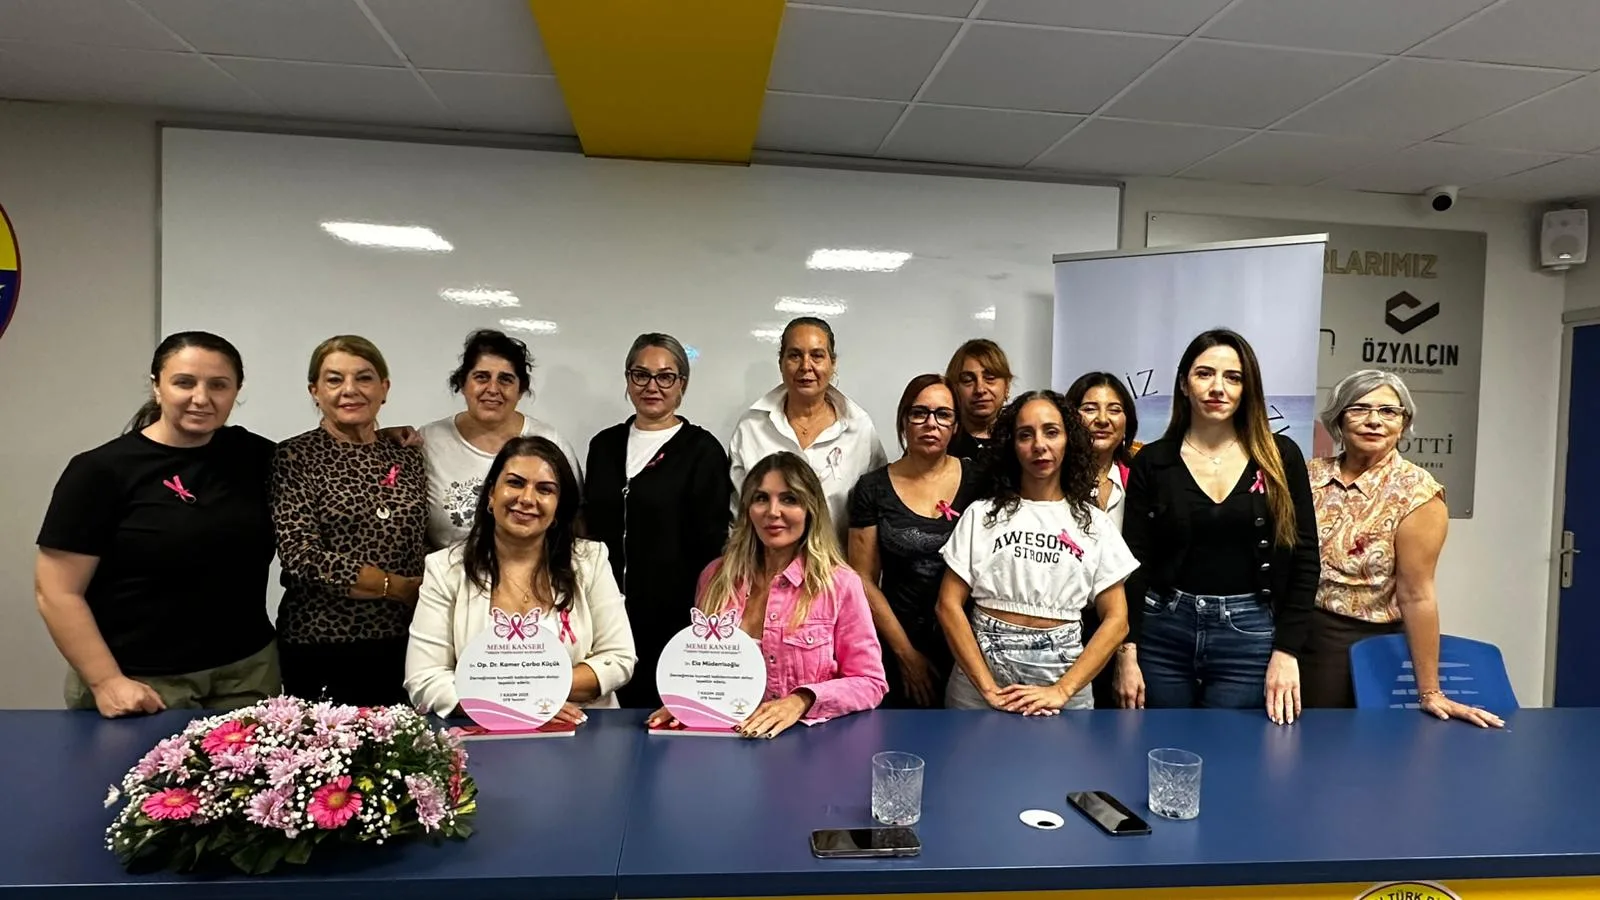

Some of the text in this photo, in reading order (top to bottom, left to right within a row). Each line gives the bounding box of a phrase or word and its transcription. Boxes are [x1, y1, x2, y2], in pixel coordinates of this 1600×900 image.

[1362, 337, 1459, 367] ÖZYALÇIN
[1395, 433, 1456, 455] OTTİ
[1014, 546, 1060, 564] STRONG
